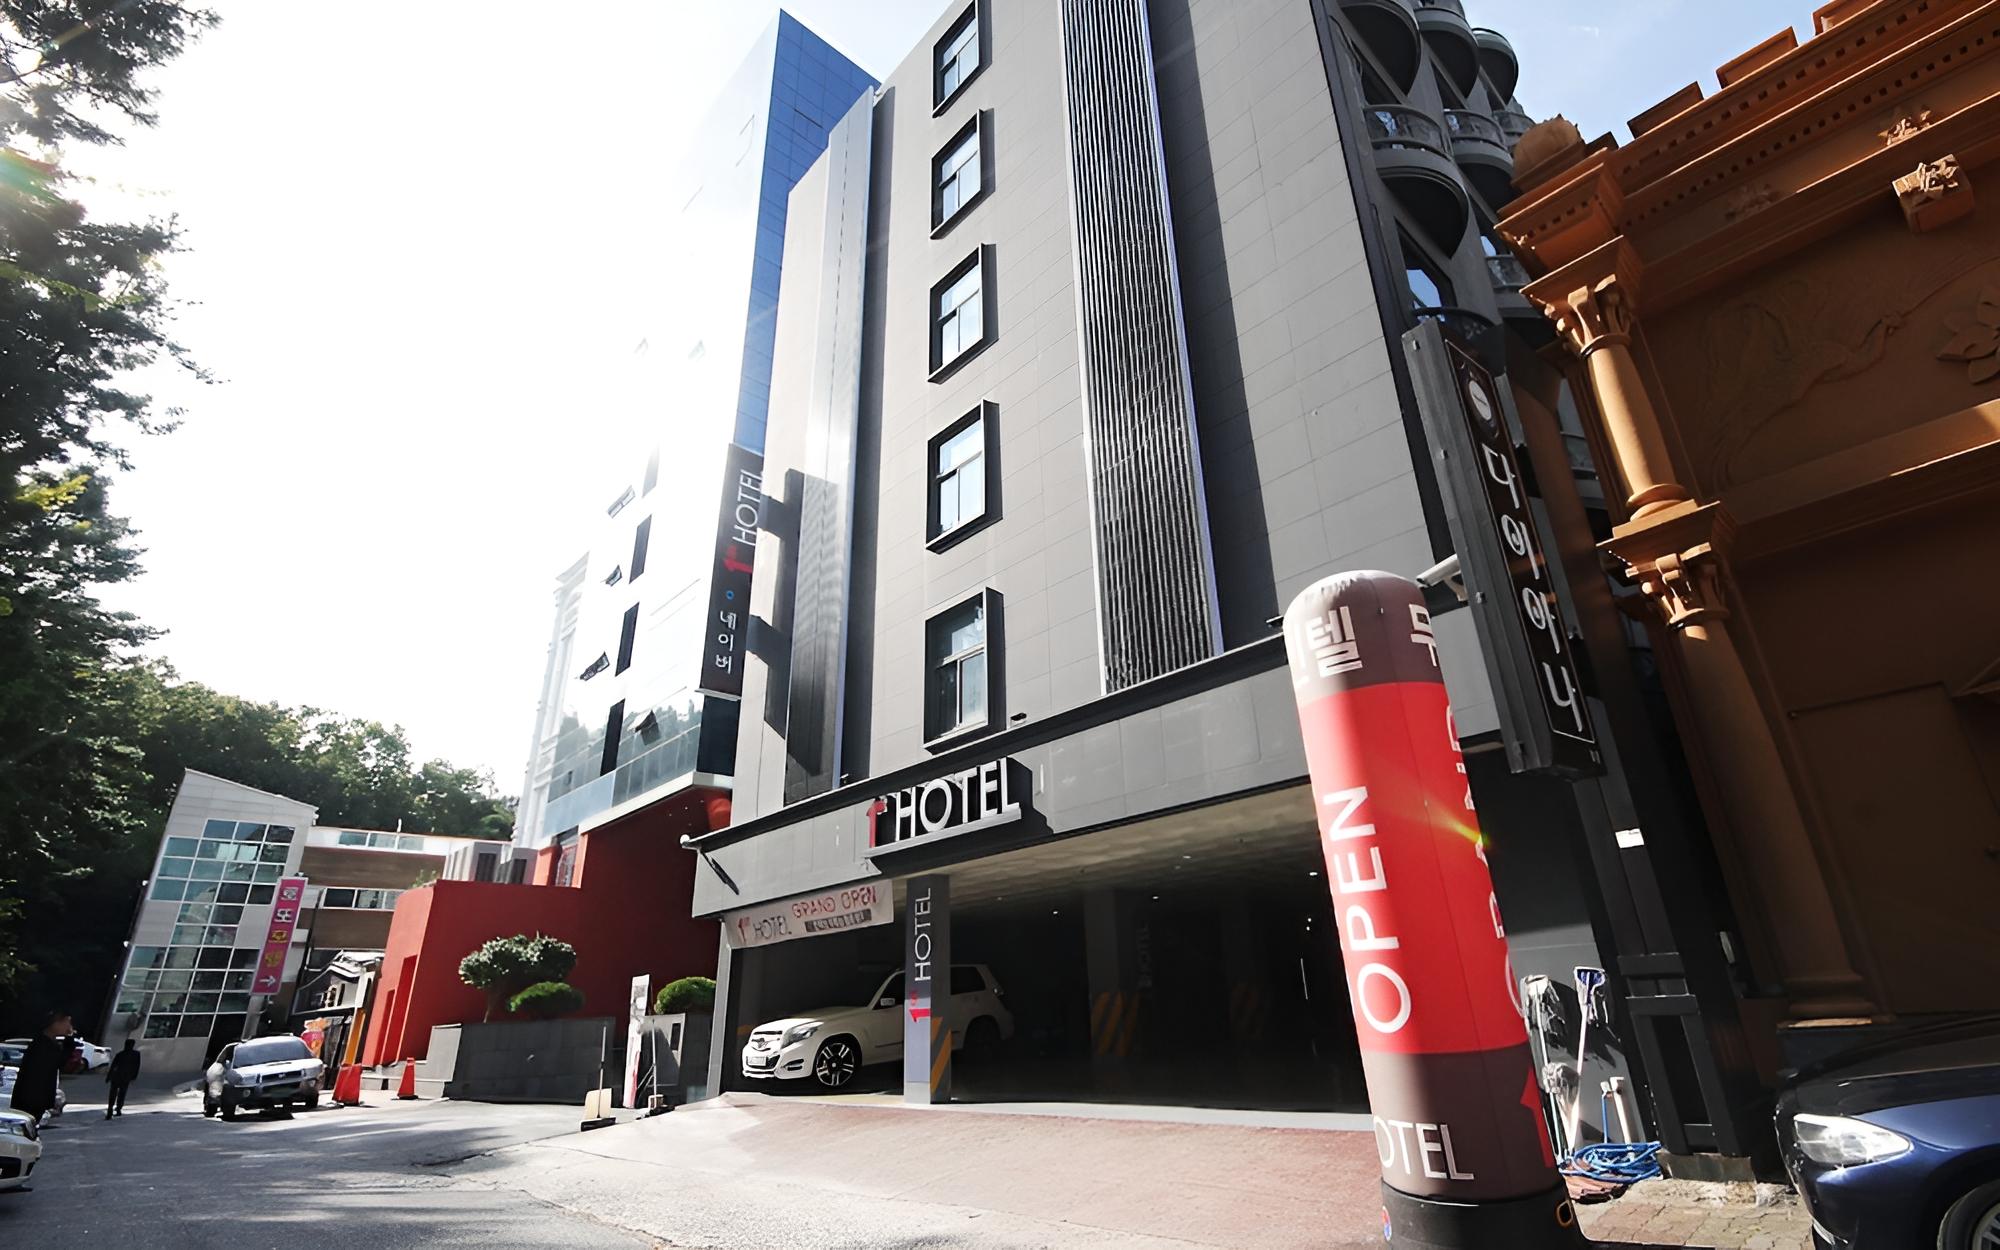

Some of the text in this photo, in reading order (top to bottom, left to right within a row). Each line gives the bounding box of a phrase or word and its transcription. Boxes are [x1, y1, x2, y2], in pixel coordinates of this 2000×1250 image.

[1481, 442, 1584, 733] 다이아나
[895, 757, 1020, 841] HOTEL
[841, 885, 877, 909] OPEN
[914, 888, 931, 982] HOTEL
[1323, 786, 1412, 1033] OPEN
